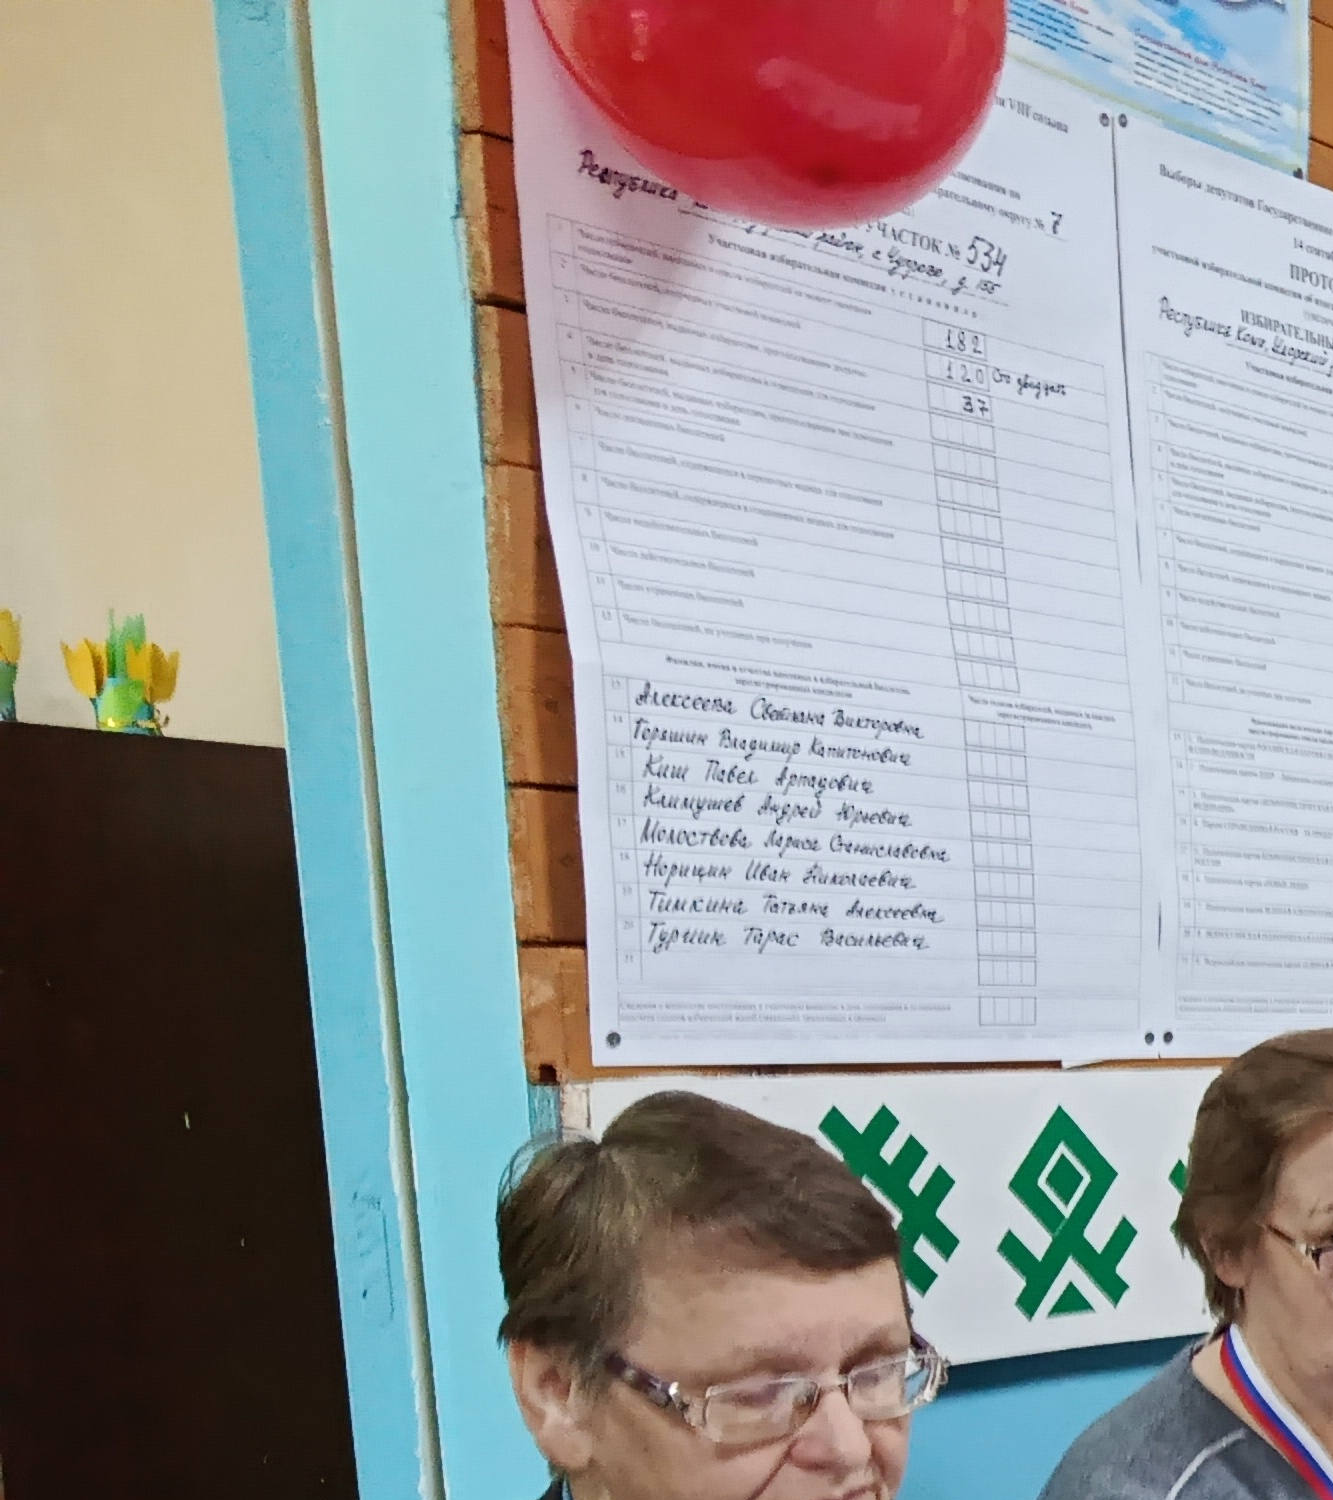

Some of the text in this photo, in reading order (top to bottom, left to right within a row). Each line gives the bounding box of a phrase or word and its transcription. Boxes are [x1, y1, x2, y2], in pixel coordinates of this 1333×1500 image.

[1159, 163, 1201, 189] Выборы
[966, 236, 1008, 277] 534
[945, 328, 983, 355] 182
[634, 681, 738, 716] Алексеева
[832, 709, 926, 740] Викторовна
[718, 728, 801, 763] Владимир
[704, 759, 759, 786] Павел
[763, 828, 823, 858] Лариса
[745, 859, 792, 884] Иван
[802, 861, 917, 891] Николаевич
[845, 899, 945, 925] Алексеевна
[743, 927, 800, 955] Тарас
